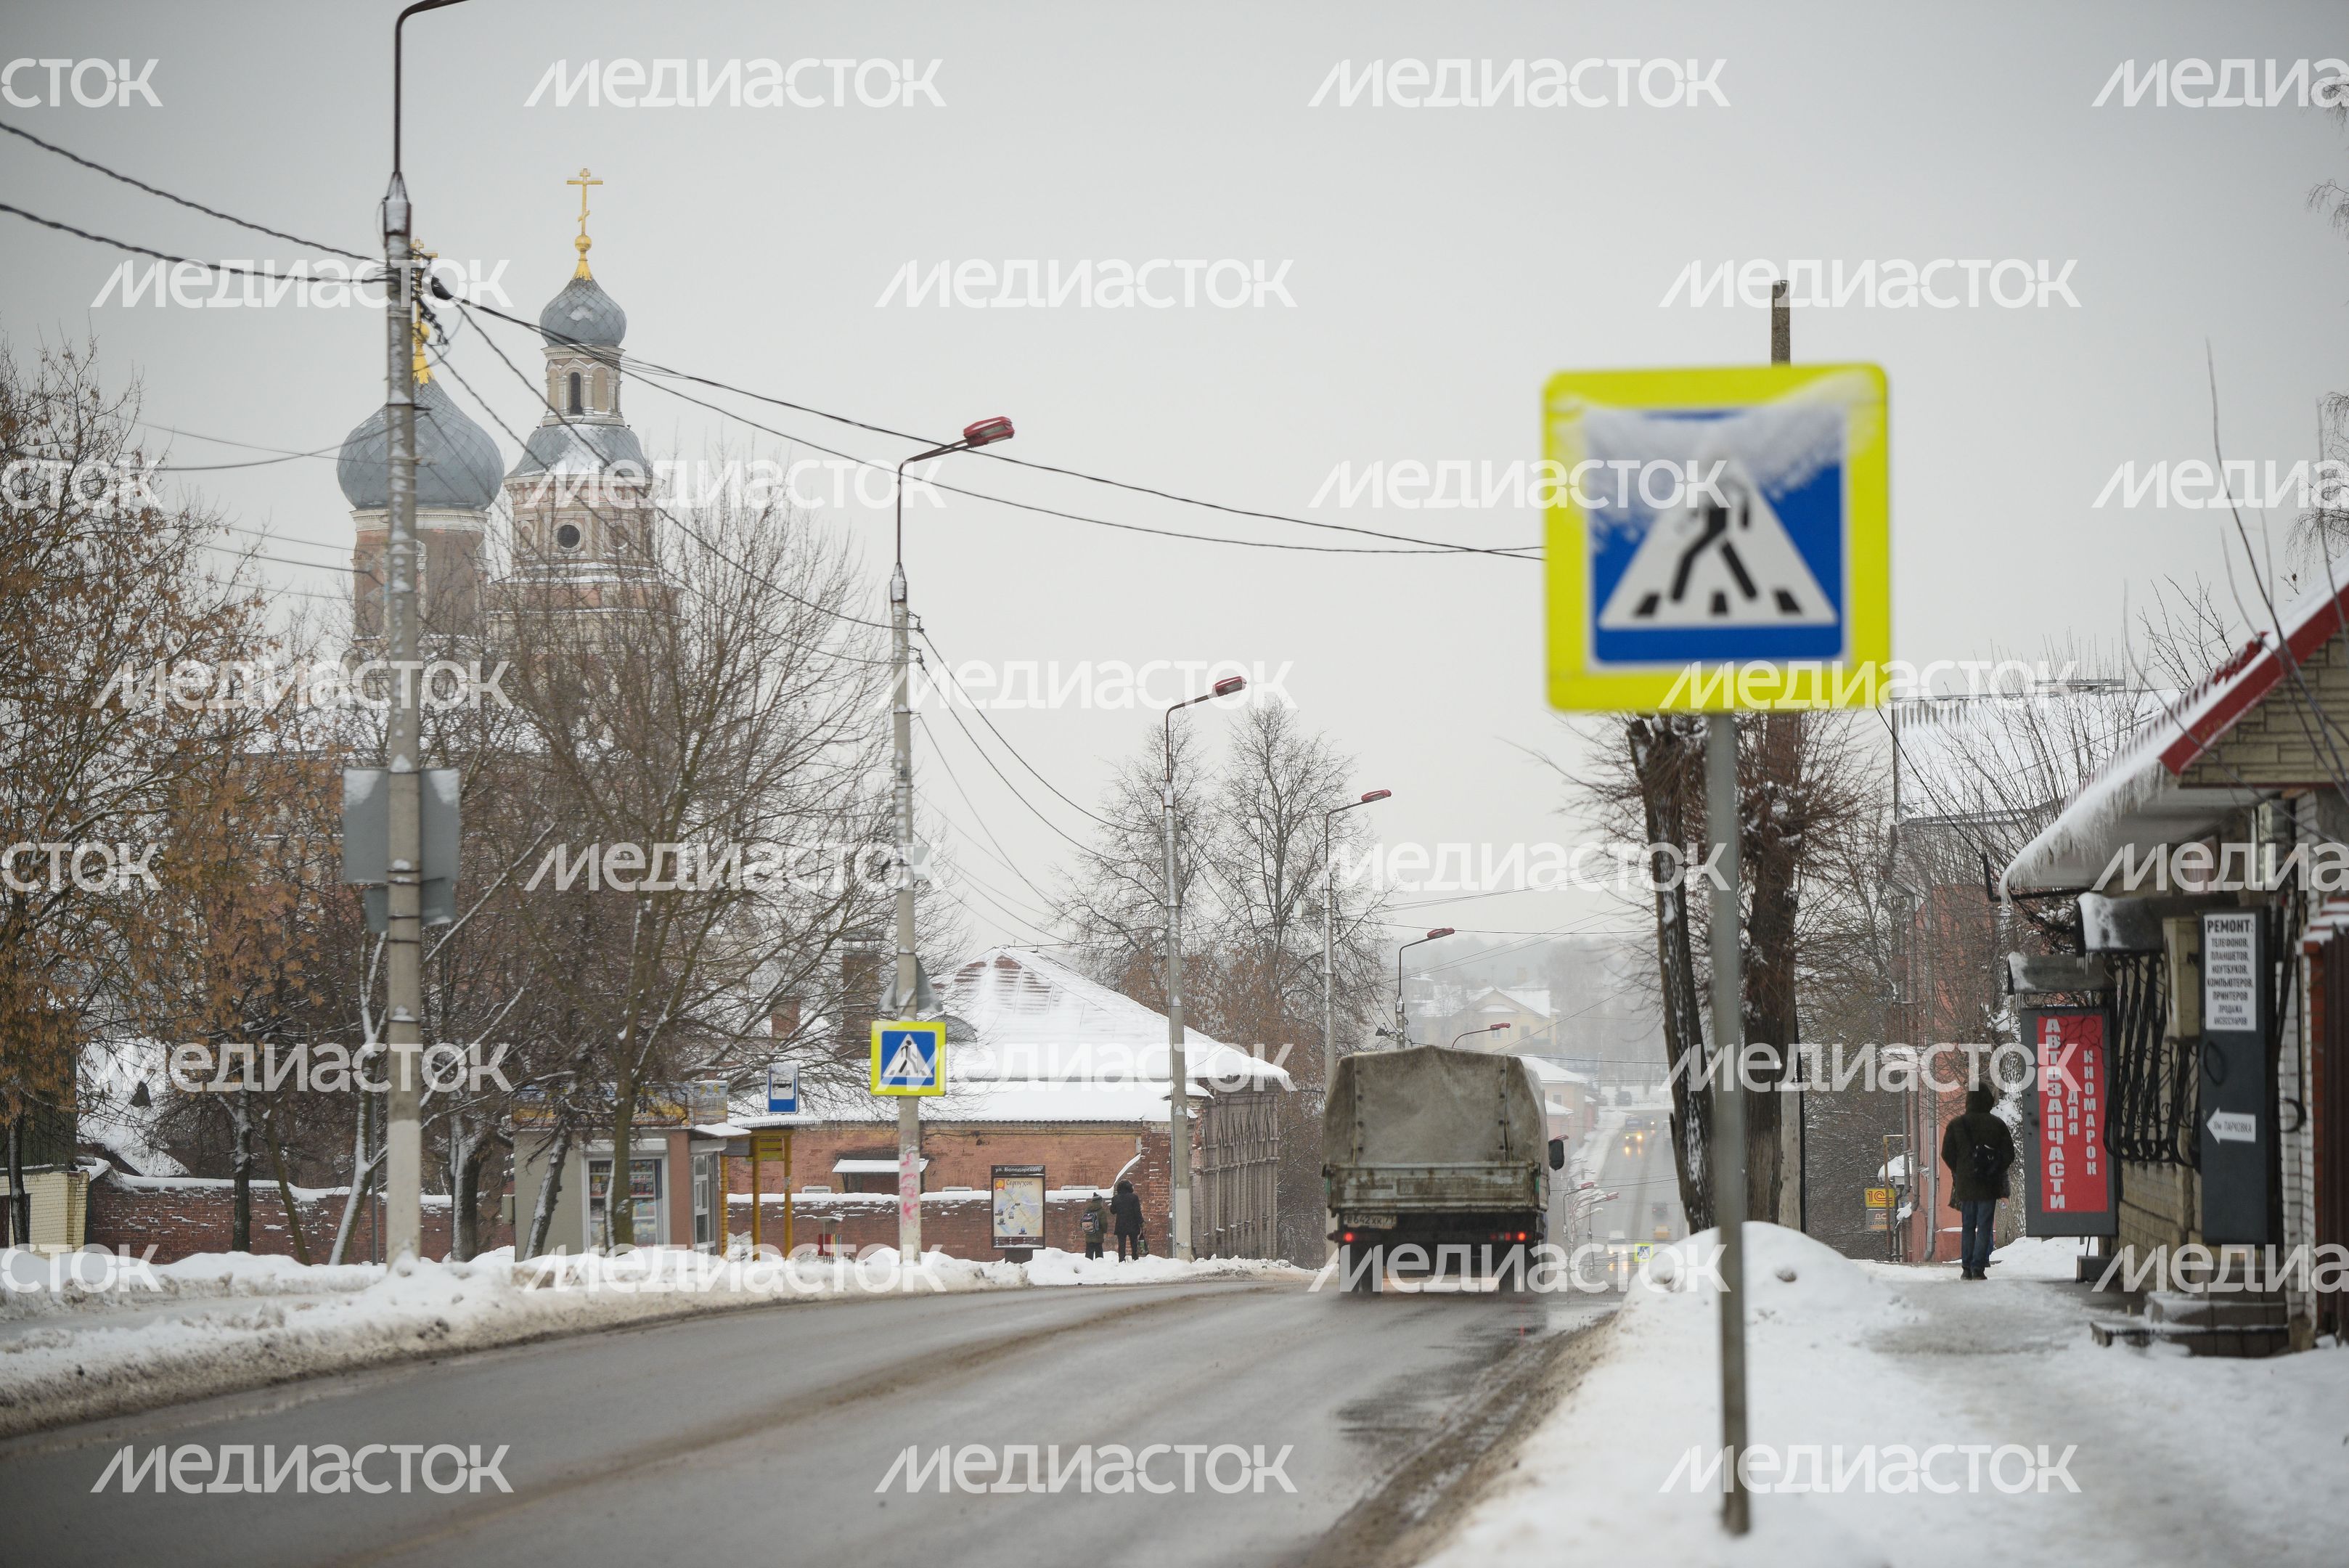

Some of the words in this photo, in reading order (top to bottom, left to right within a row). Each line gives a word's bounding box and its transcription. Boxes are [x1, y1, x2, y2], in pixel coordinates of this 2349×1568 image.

[2045, 1018, 2065, 1209] АВТОЗАПЧАСТИ
[2067, 1090, 2079, 1135] ДЛЯ
[2083, 1050, 2097, 1175] ИНОМАРОК
